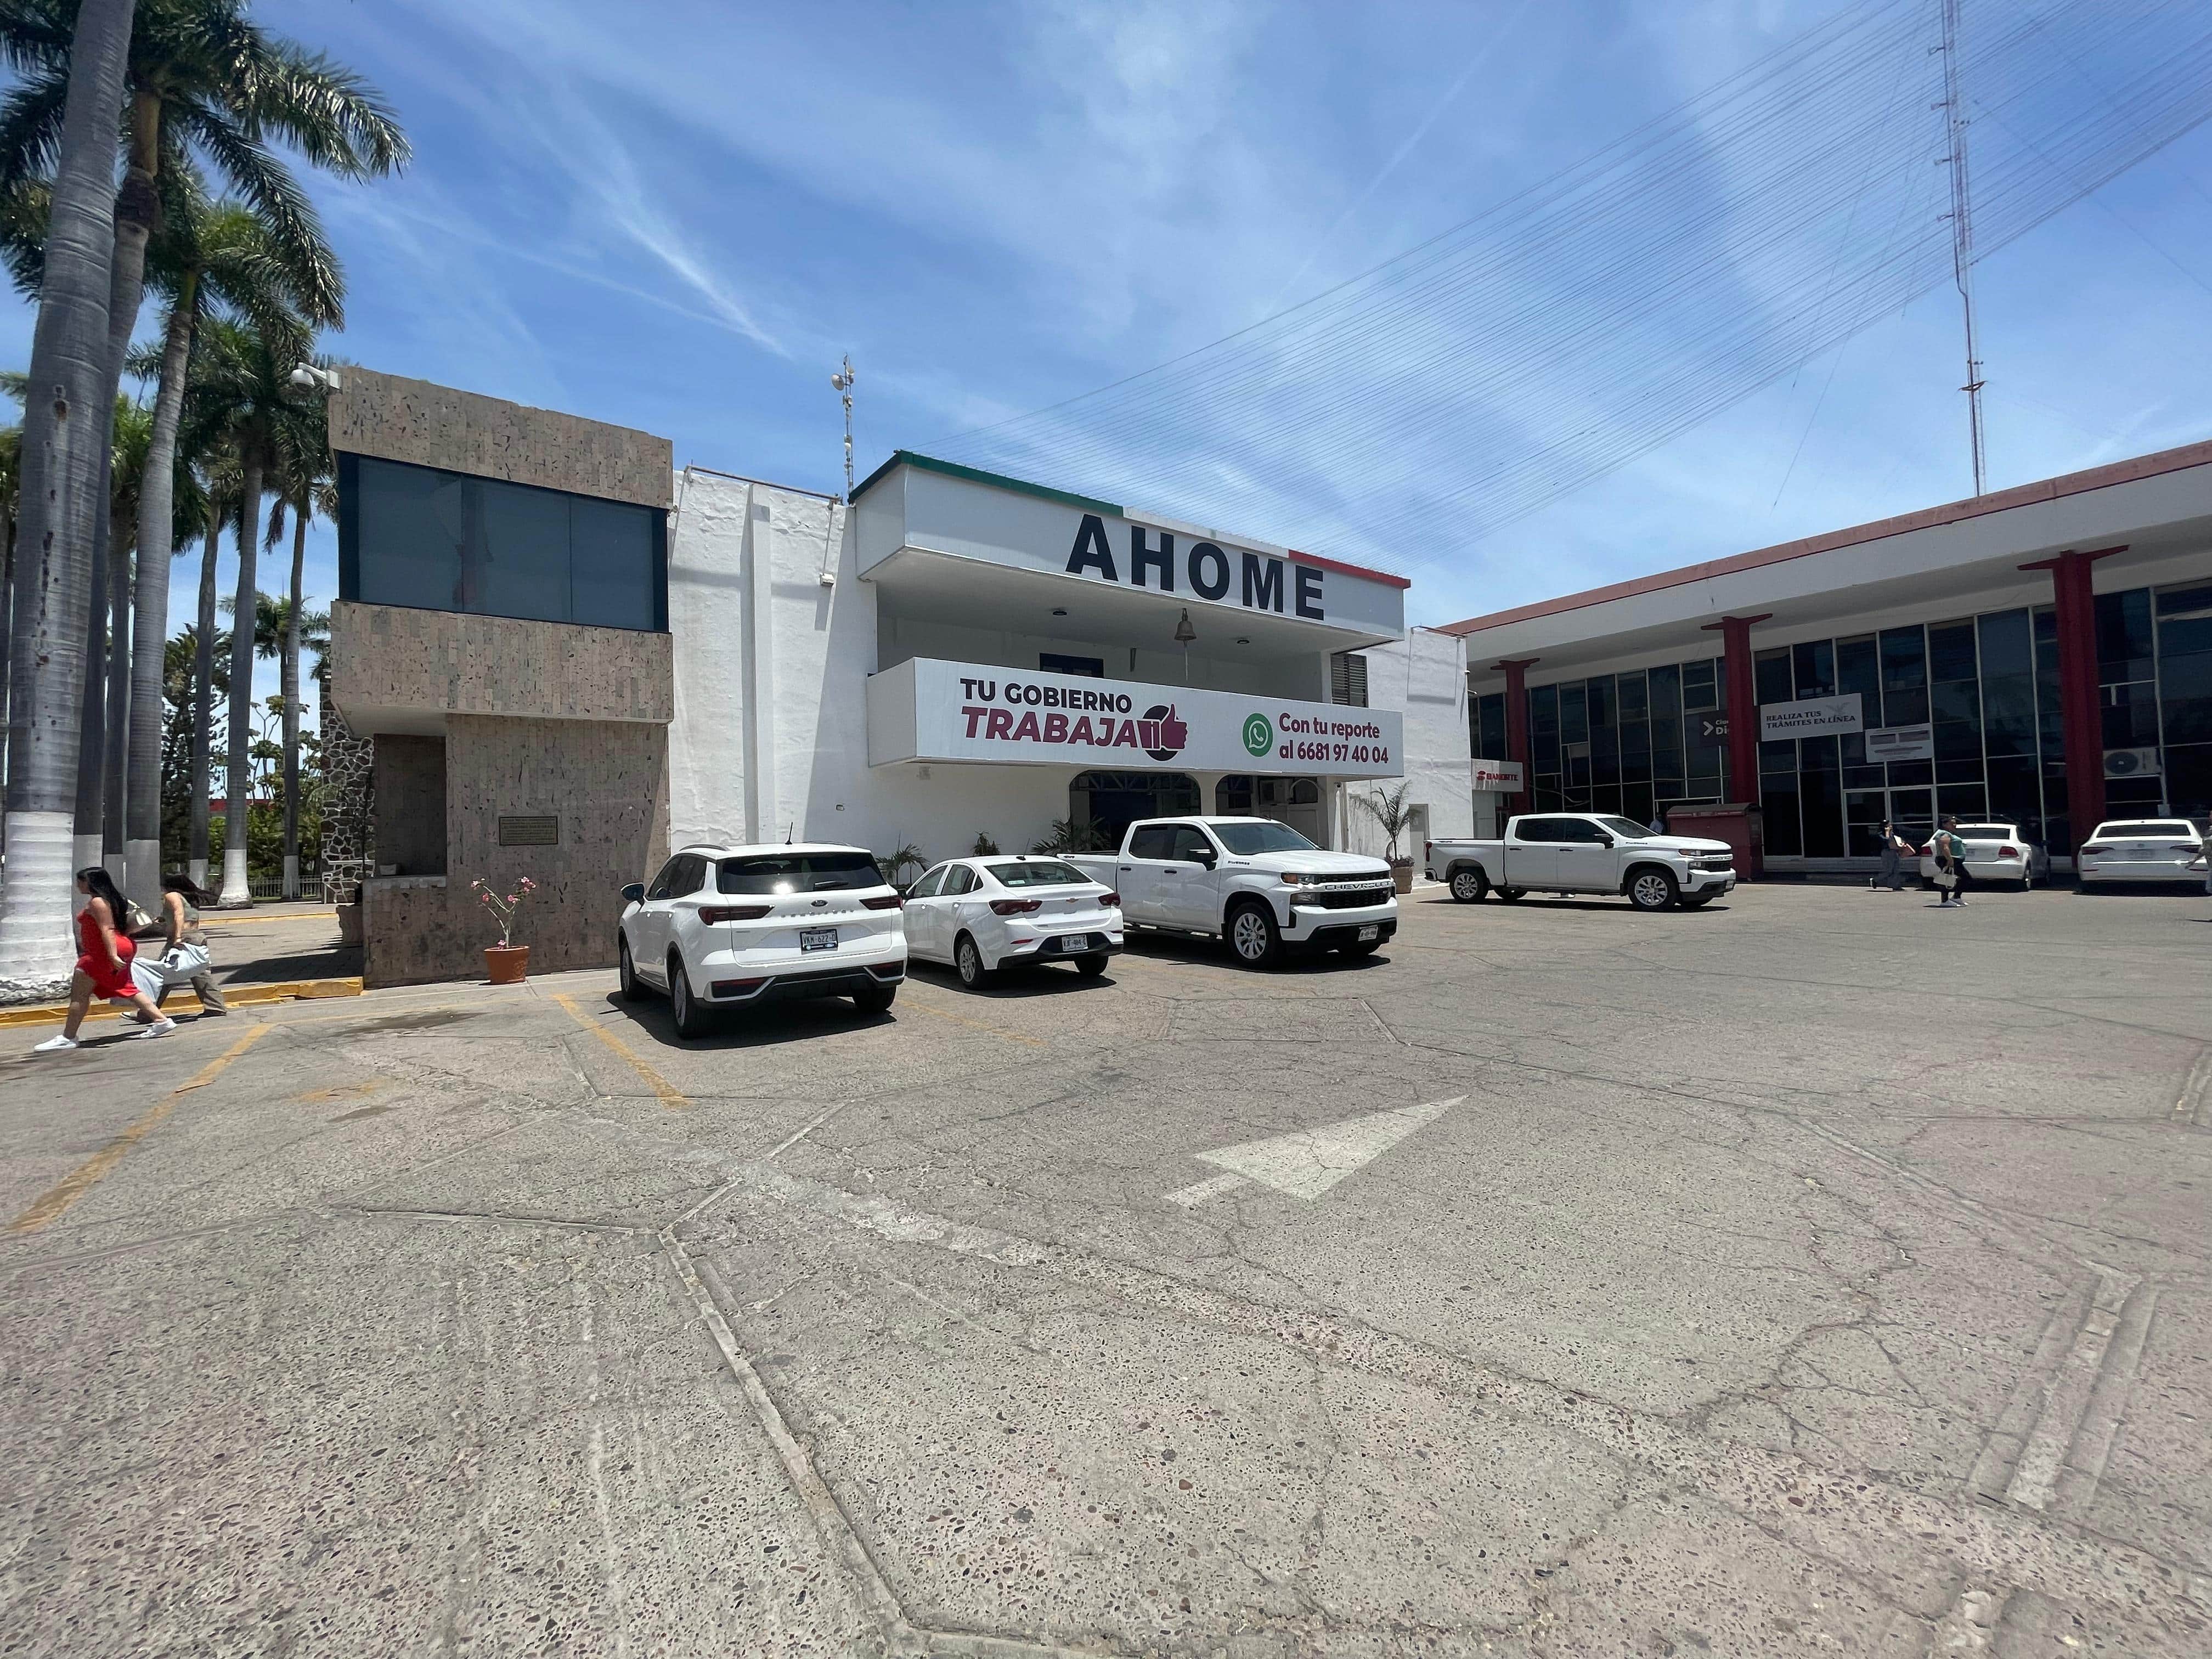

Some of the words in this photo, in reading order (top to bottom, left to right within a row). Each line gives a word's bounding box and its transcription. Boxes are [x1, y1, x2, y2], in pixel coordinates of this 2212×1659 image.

[1065, 514, 1324, 620] AHOME
[960, 678, 996, 702] TU
[1004, 682, 1132, 714] GOBIERNO
[961, 706, 1138, 748] TRABAJA
[1279, 713, 1310, 733] Con
[1313, 717, 1328, 735] tu
[1331, 722, 1380, 741] reporte
[1766, 712, 1802, 721] REALIZA
[1826, 715, 1856, 724] LÍNEA
[1279, 740, 1294, 759] al
[1297, 741, 1329, 761] 6681
[1333, 743, 1348, 761] 97
[1352, 745, 1369, 763] 40
[1372, 746, 1389, 764] 04
[1325, 881, 1389, 890] CHEVROLET
